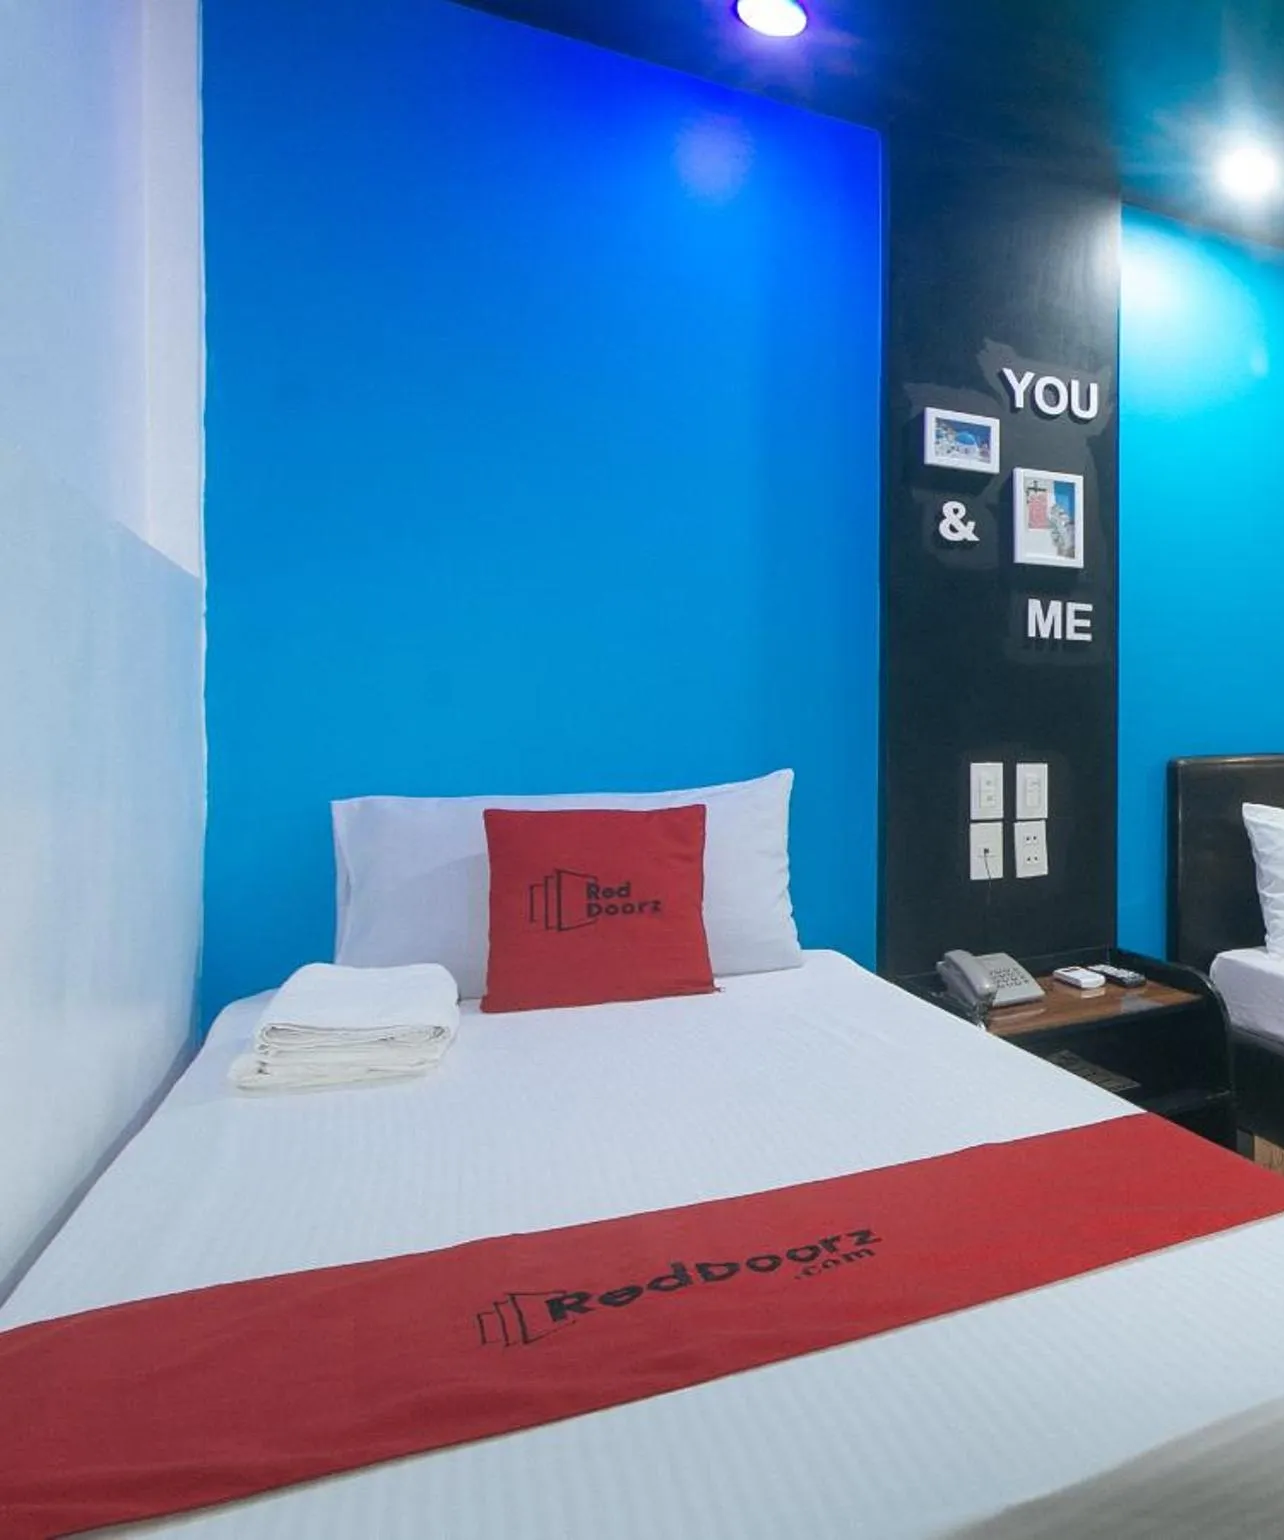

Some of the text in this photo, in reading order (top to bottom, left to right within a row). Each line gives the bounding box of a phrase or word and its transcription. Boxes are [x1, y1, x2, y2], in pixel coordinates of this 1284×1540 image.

[1002, 367, 1099, 420] YOU
[938, 500, 980, 542] &
[1027, 598, 1094, 642] ME
[586, 881, 631, 900] Red
[587, 900, 662, 918] Doorz
[544, 1228, 882, 1323] RedDoorz
